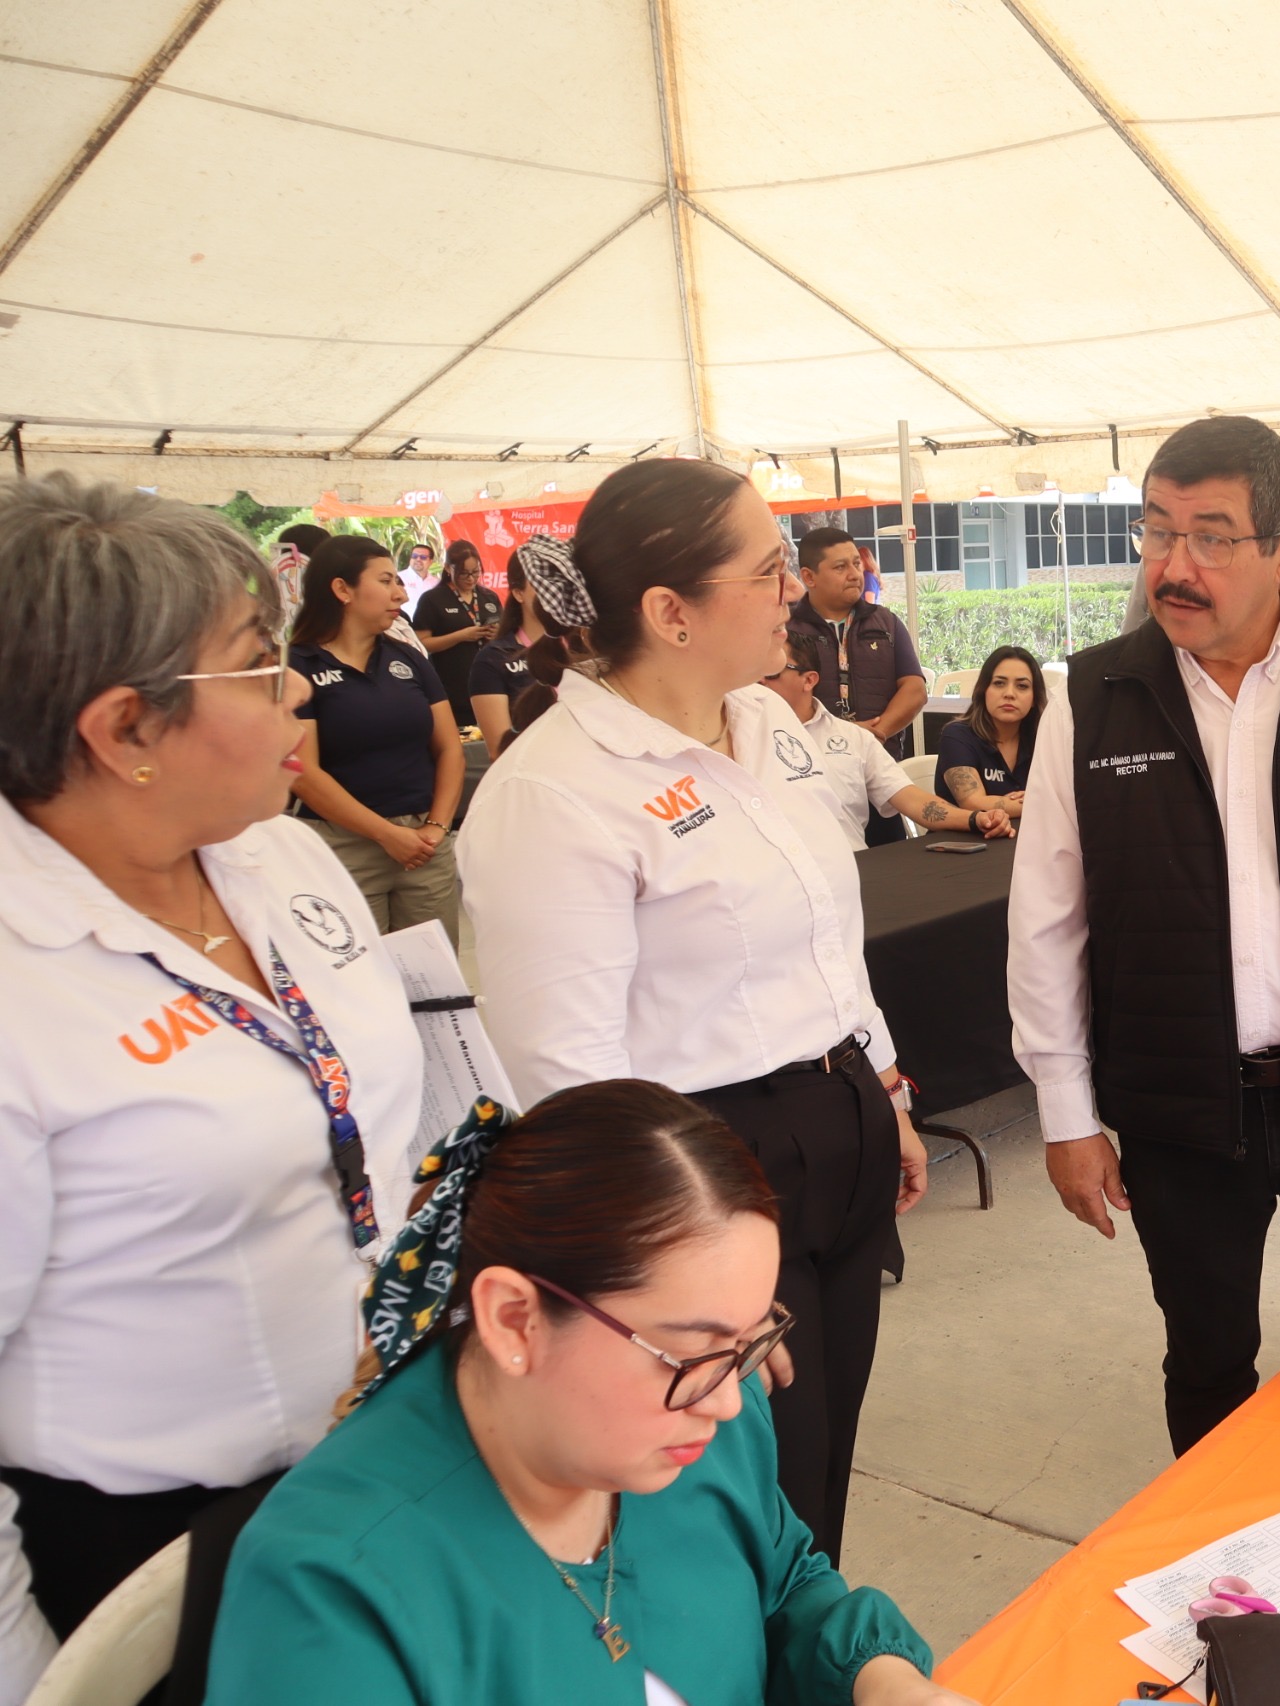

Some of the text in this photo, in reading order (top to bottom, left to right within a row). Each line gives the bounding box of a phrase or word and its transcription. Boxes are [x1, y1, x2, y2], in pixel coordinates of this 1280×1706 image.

[511, 510, 544, 521] Hospital
[511, 521, 577, 534] Tierra San
[506, 660, 528, 673] UA
[312, 669, 344, 687] UAT
[1149, 752, 1176, 761] ALVARADO
[984, 768, 1006, 782] UAT
[1116, 763, 1148, 776] RECTOR
[643, 775, 702, 821] UAT
[118, 993, 219, 1065] UAT
[459, 1040, 483, 1092] Manzana
[317, 1053, 351, 1107] UAT
[369, 1279, 413, 1352] IMSS
